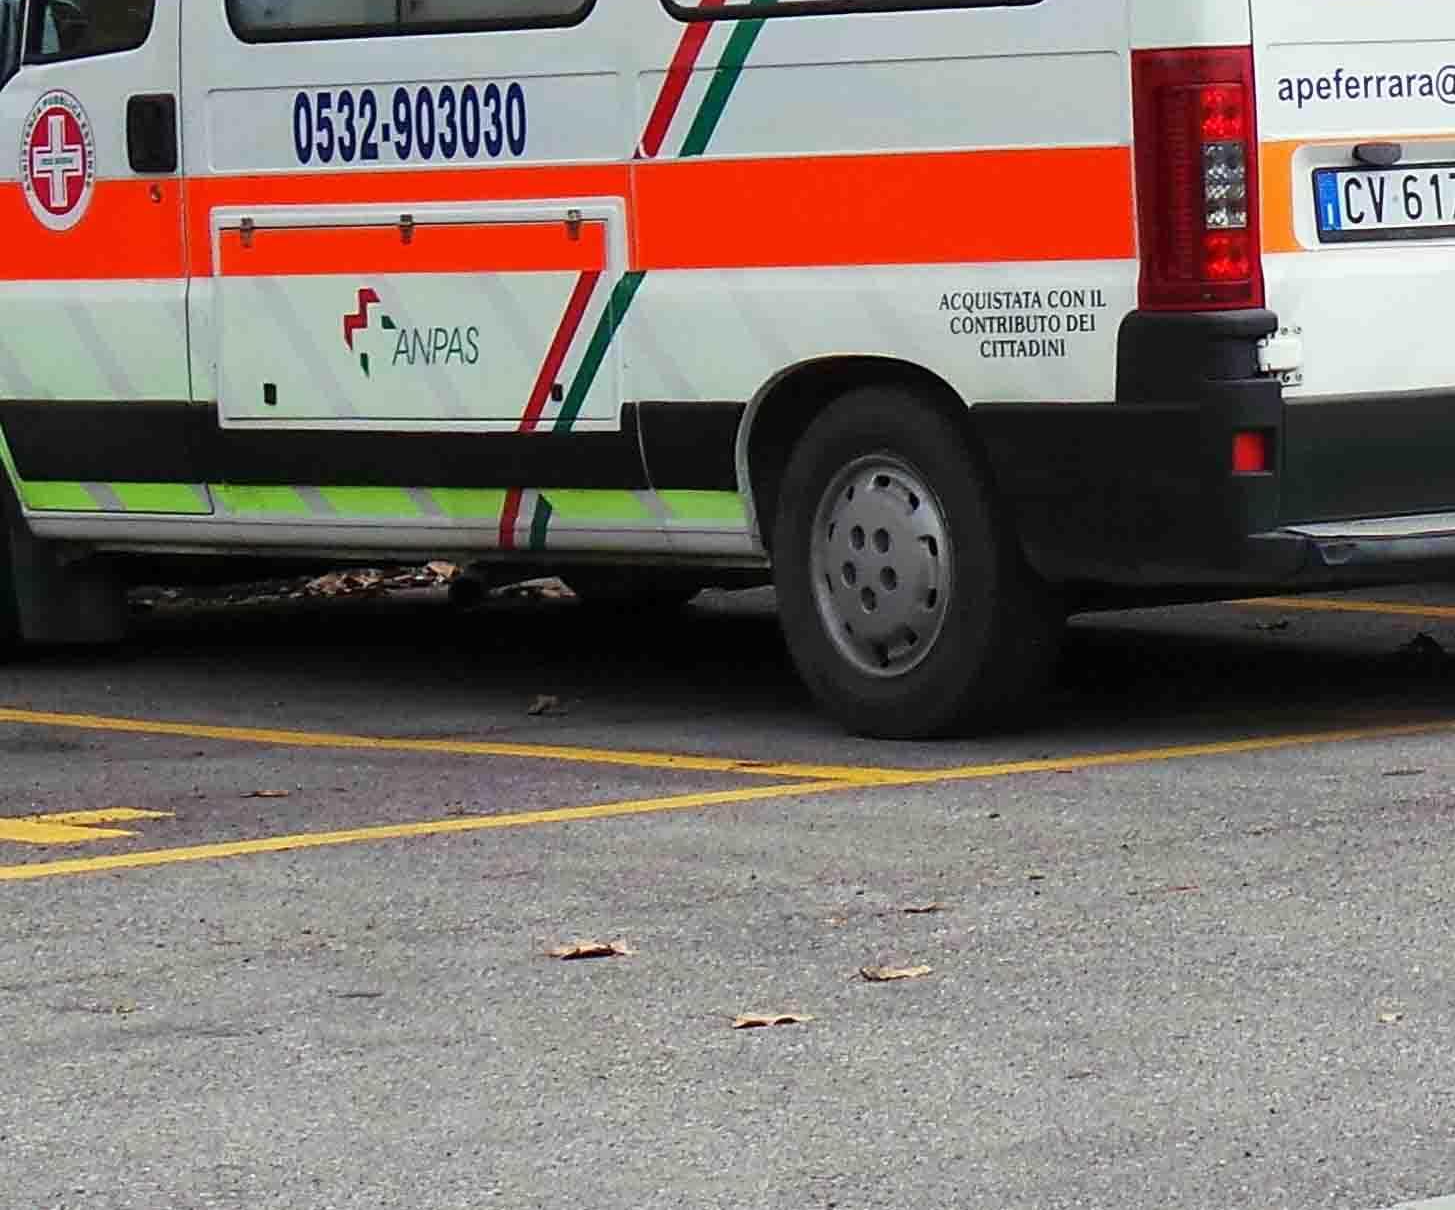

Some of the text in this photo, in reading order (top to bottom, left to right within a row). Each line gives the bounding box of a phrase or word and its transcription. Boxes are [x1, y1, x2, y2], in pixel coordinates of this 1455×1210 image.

[293, 82, 527, 165] 0532-903030
[1344, 177, 1385, 224] CV
[938, 289, 1108, 313] ACQUISTATA CON IL
[950, 313, 1097, 335] CONTRIBUTO DEI
[391, 325, 480, 366] ANPAS
[980, 338, 1066, 359] CITTADINI
